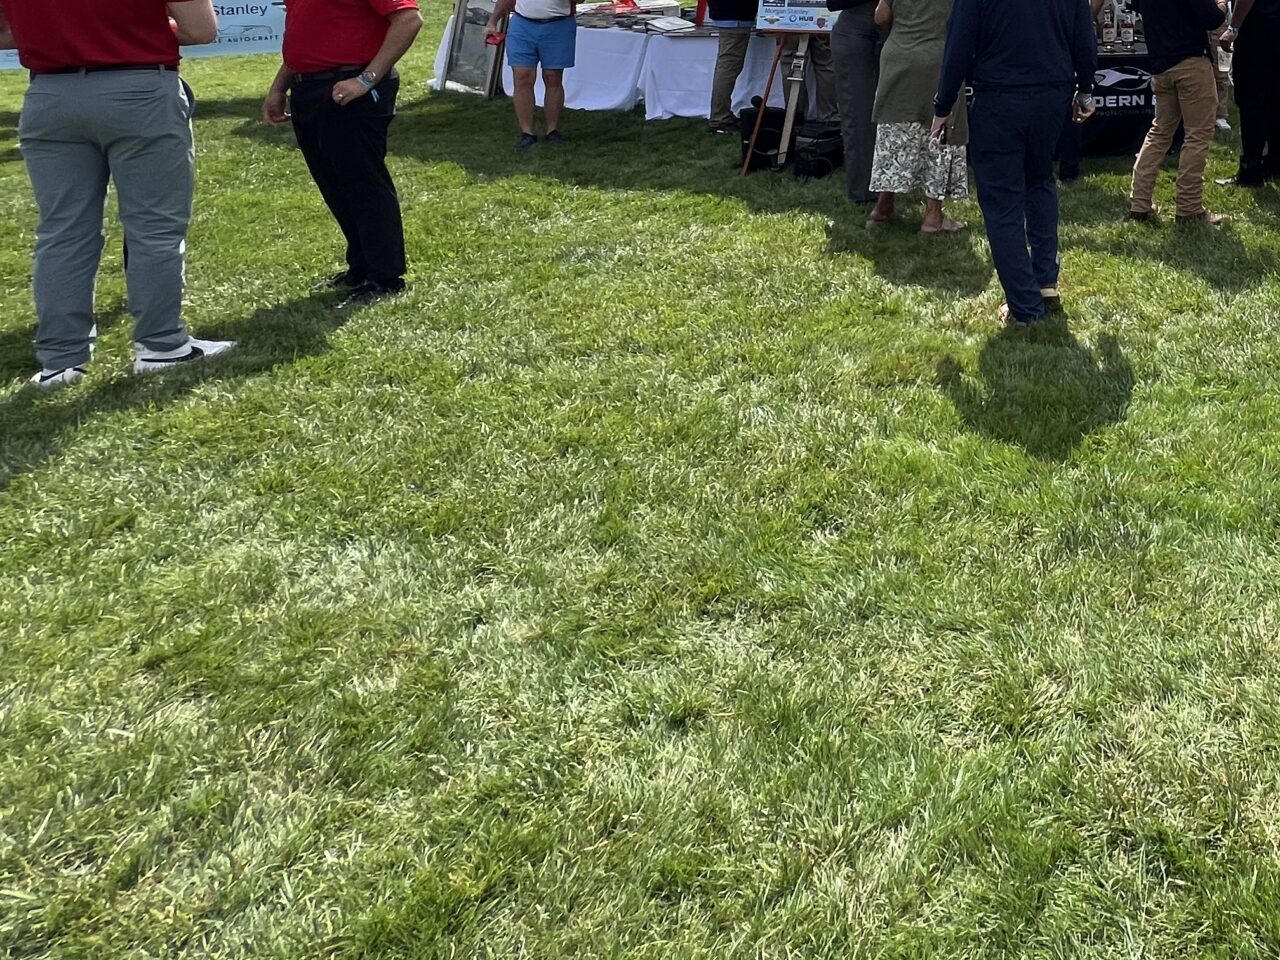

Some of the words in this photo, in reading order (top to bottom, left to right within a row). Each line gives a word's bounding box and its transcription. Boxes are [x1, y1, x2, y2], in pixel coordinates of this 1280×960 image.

[213, 3, 268, 17] Stanley
[227, 35, 279, 43] AUTOCRAFT
[1092, 94, 1145, 107] DERN
